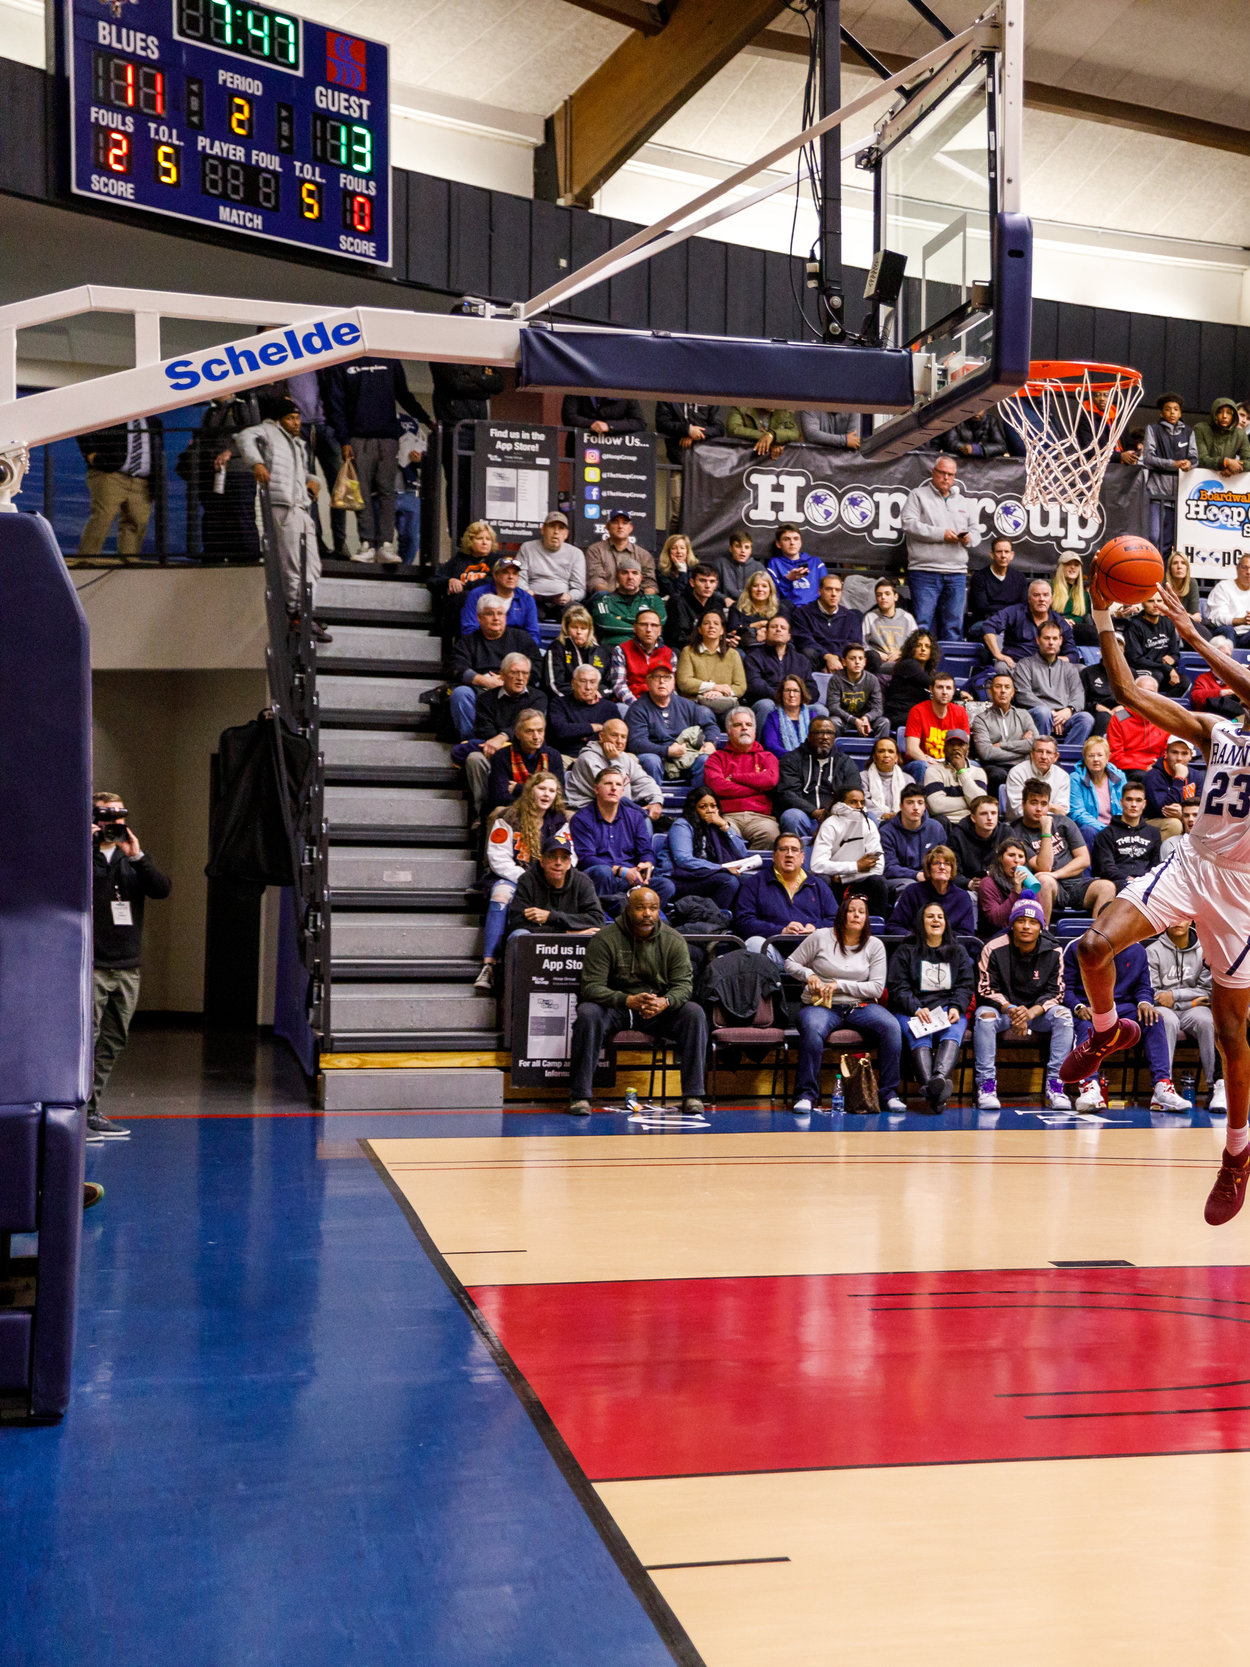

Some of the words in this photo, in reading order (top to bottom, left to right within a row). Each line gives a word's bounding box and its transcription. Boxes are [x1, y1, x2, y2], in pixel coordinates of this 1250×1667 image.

[98, 21, 159, 59] BLUES
[211, 0, 295, 64] 7:47
[126, 63, 163, 115] 11
[218, 69, 263, 96] PERIOD
[315, 85, 371, 120] GUEST
[90, 106, 134, 132] FOULS
[231, 97, 250, 136] 2
[148, 122, 185, 146] T.O.L.
[109, 131, 128, 172] 2
[198, 136, 246, 162] PLAYER
[252, 149, 283, 172] FOUL
[340, 125, 372, 173] 13
[157, 145, 177, 184] 5
[293, 161, 327, 183] T.O.L.
[90, 174, 135, 200] SCORE
[339, 173, 377, 196] FOULS
[302, 182, 320, 219] 5
[353, 195, 371, 232] 0
[218, 205, 263, 231] MATCH
[339, 235, 377, 257] SCORE
[165, 322, 361, 390] Schelde
[490, 428, 509, 440] Find
[510, 430, 520, 440] us
[521, 430, 531, 440] in
[531, 430, 546, 441] the
[495, 441, 513, 452] App
[514, 442, 540, 452] Store!
[583, 432, 622, 446] Follow
[1186, 500, 1246, 528] Hoop
[536, 944, 559, 955] Find
[561, 945, 574, 955] us
[576, 945, 586, 955] in
[542, 959, 563, 971] App
[565, 960, 583, 970] Sto
[518, 1059, 530, 1068] For
[532, 1059, 541, 1067] all
[542, 1060, 562, 1069] Camp
